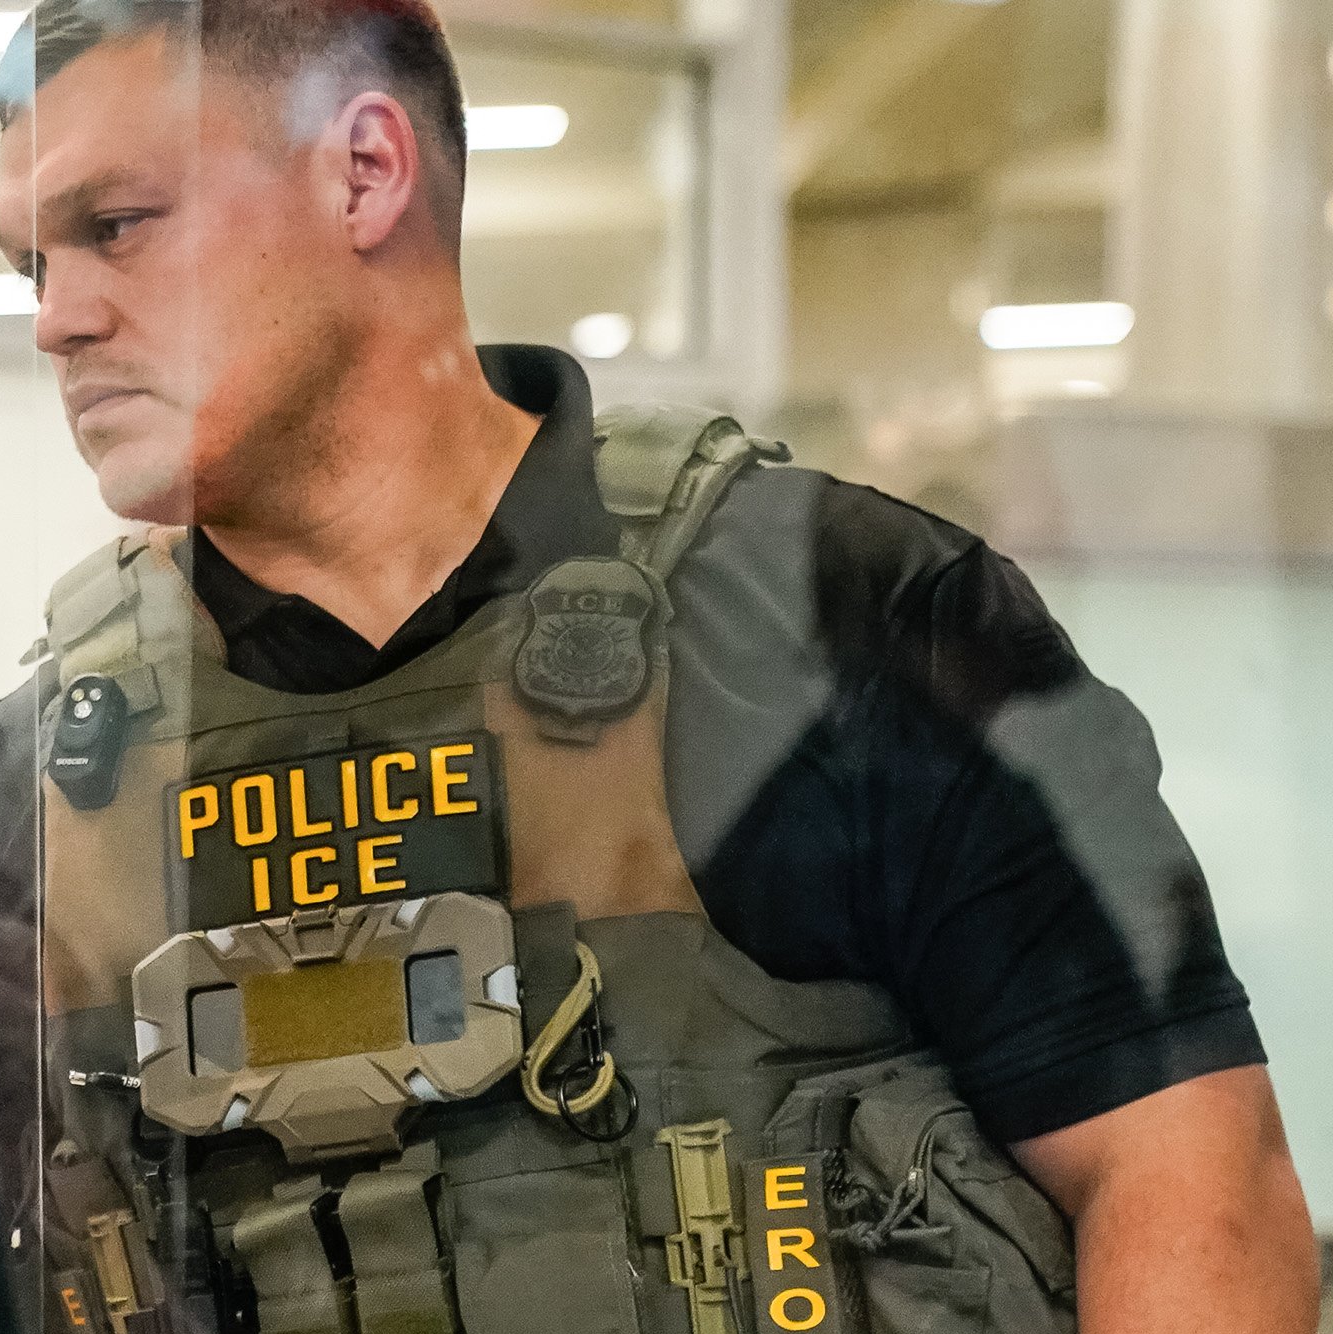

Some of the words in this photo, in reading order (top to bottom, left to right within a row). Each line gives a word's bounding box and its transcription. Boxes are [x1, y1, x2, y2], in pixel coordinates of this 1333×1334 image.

[179, 744, 478, 859] POLICE
[252, 835, 406, 912] ICE
[765, 1167, 826, 1331] ERO
